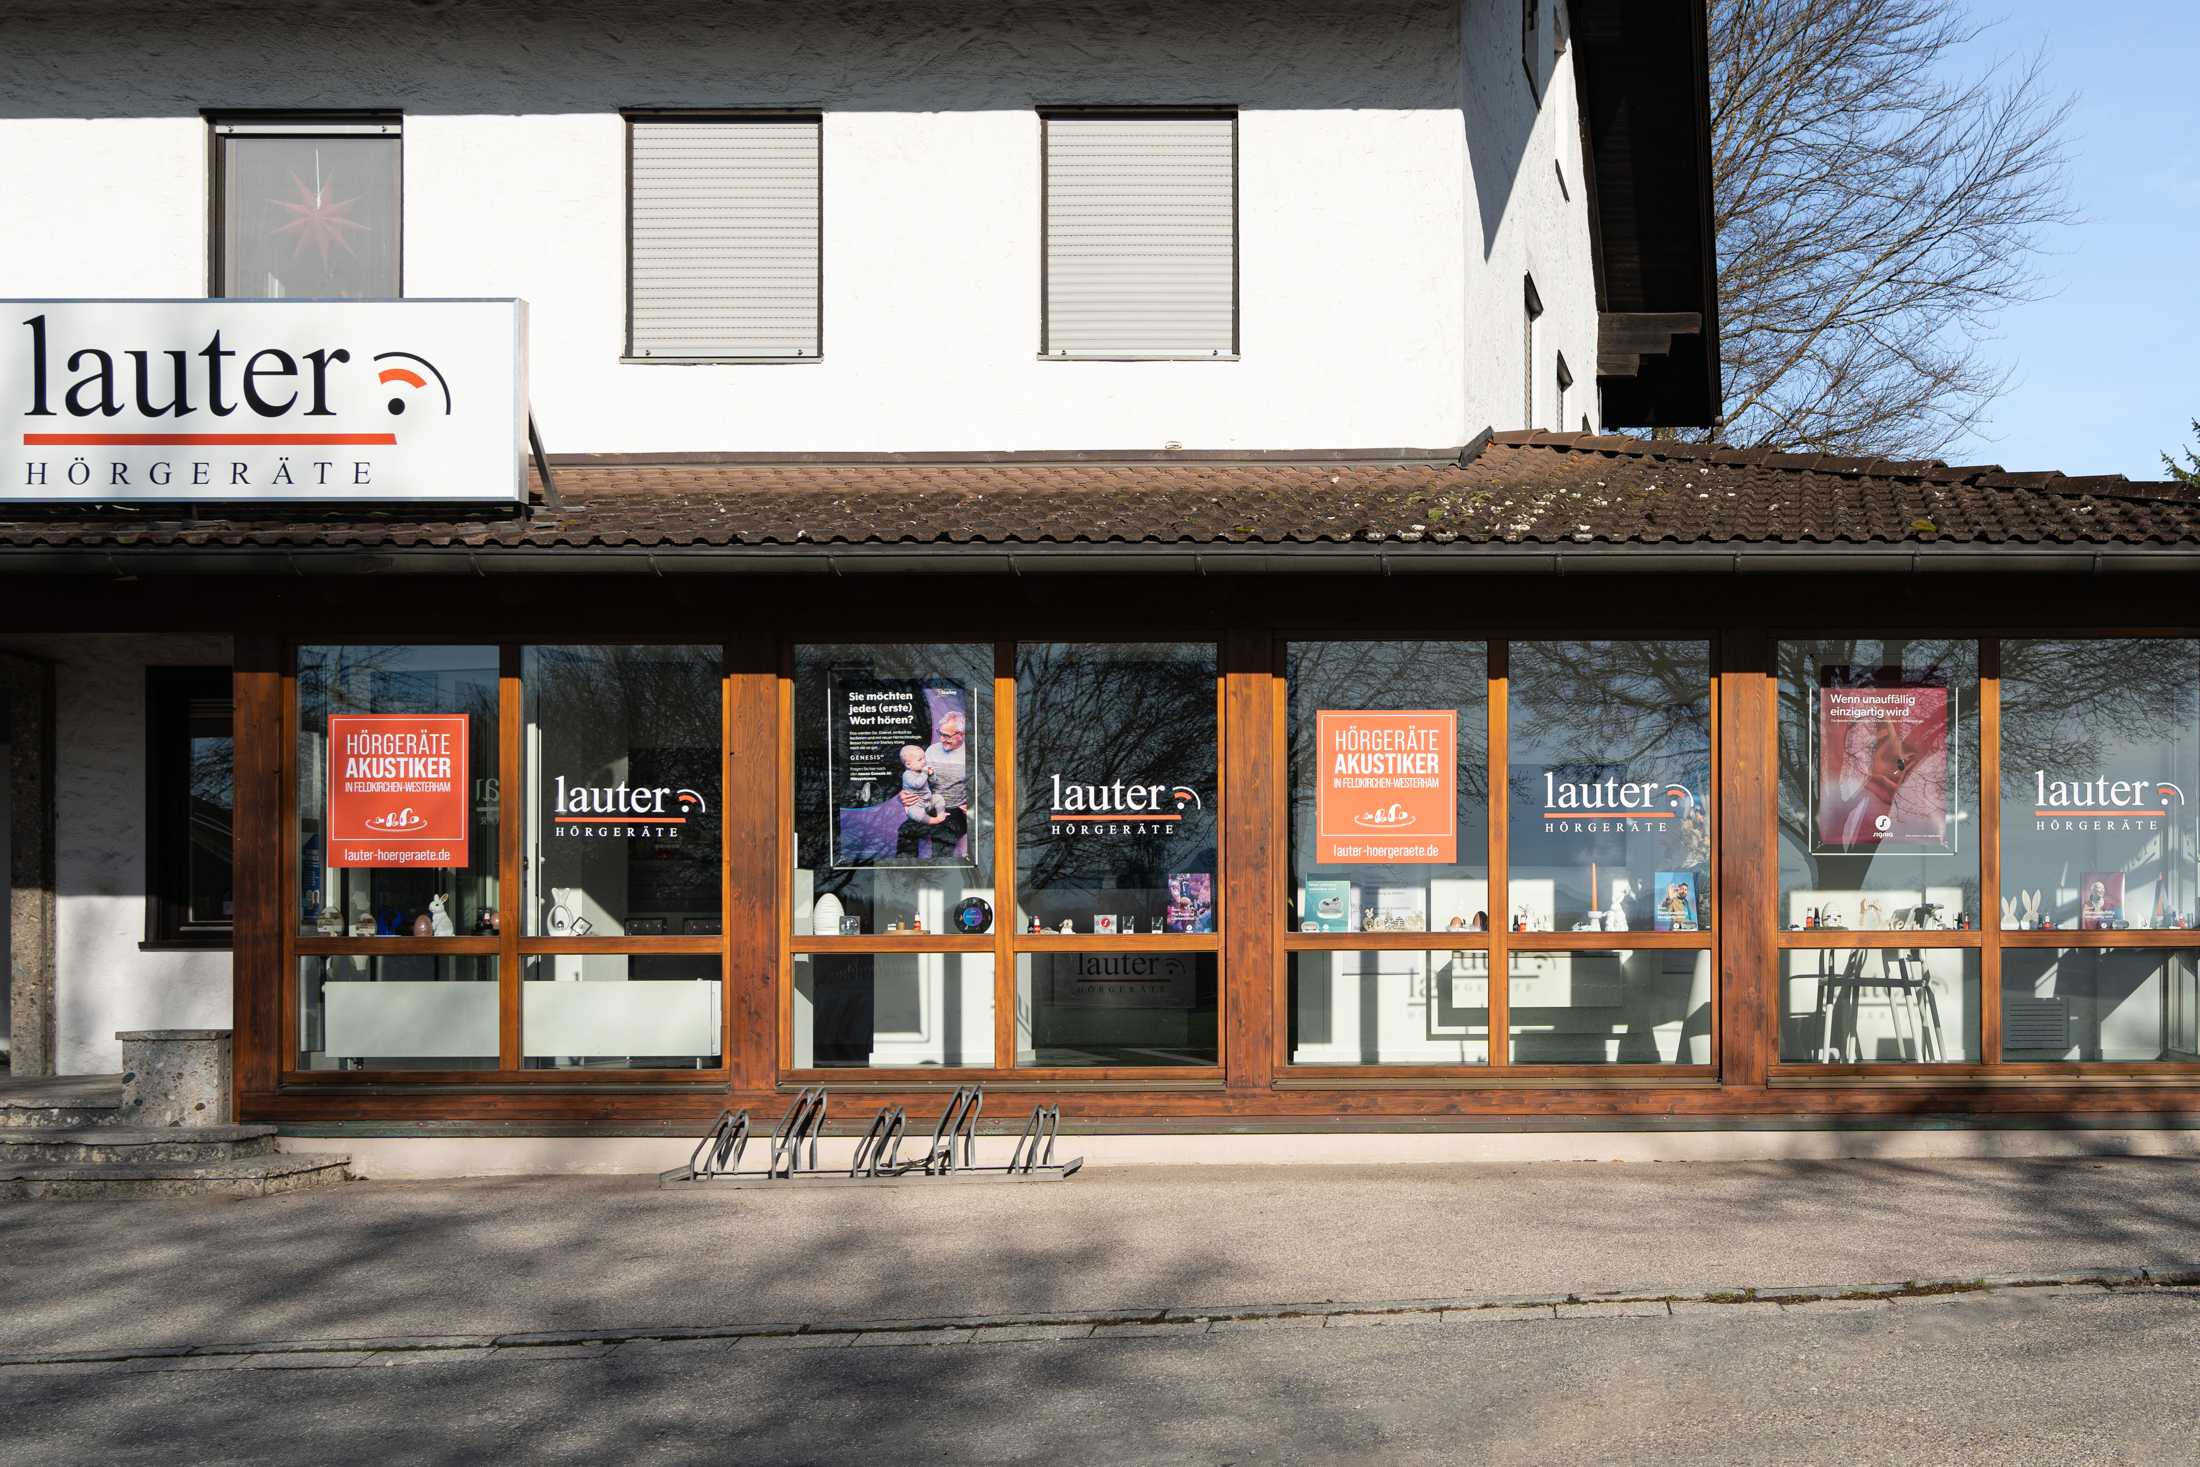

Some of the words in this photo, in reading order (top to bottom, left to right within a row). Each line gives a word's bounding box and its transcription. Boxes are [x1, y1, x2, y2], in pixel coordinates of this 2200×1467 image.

[22, 314, 351, 418] lauter
[26, 457, 373, 486] HÖRGERÄTE
[849, 691, 865, 701] Sie
[866, 691, 913, 701] möchten
[1830, 694, 1861, 704] Wenn
[1862, 693, 1916, 706] unauffällig
[848, 704, 877, 715] jedes
[879, 703, 913, 714] (erste)
[1830, 706, 1885, 718] einzigartig
[1886, 706, 1910, 716] wird
[849, 715, 876, 725] Wort
[877, 715, 914, 725] hören?
[346, 729, 451, 755] HÖRGERÄTE
[1335, 725, 1439, 751] HÖRGERÄTE
[345, 757, 451, 779] AKUSTIKER
[1334, 753, 1439, 775] AKUSTIKER
[345, 781, 353, 793] IN
[354, 781, 451, 793] FELDKIRCHEN-WESTERHAM
[1334, 777, 1341, 789] IN
[1342, 777, 1440, 789] FELDKIRCHEN-WESTERHAM
[1544, 771, 1659, 809] lauter
[2035, 769, 2150, 807] lauter
[554, 775, 670, 813] lauter
[1050, 773, 1165, 811] lauter
[555, 824, 679, 837] HÖRGERÄTE
[1051, 822, 1175, 835] HÖRGERÄTE
[2036, 818, 2159, 831] HÖRGERÄTE
[344, 848, 451, 863] lauter-hoergeraete.de
[1333, 843, 1440, 860] lauter-hoergeraete.de
